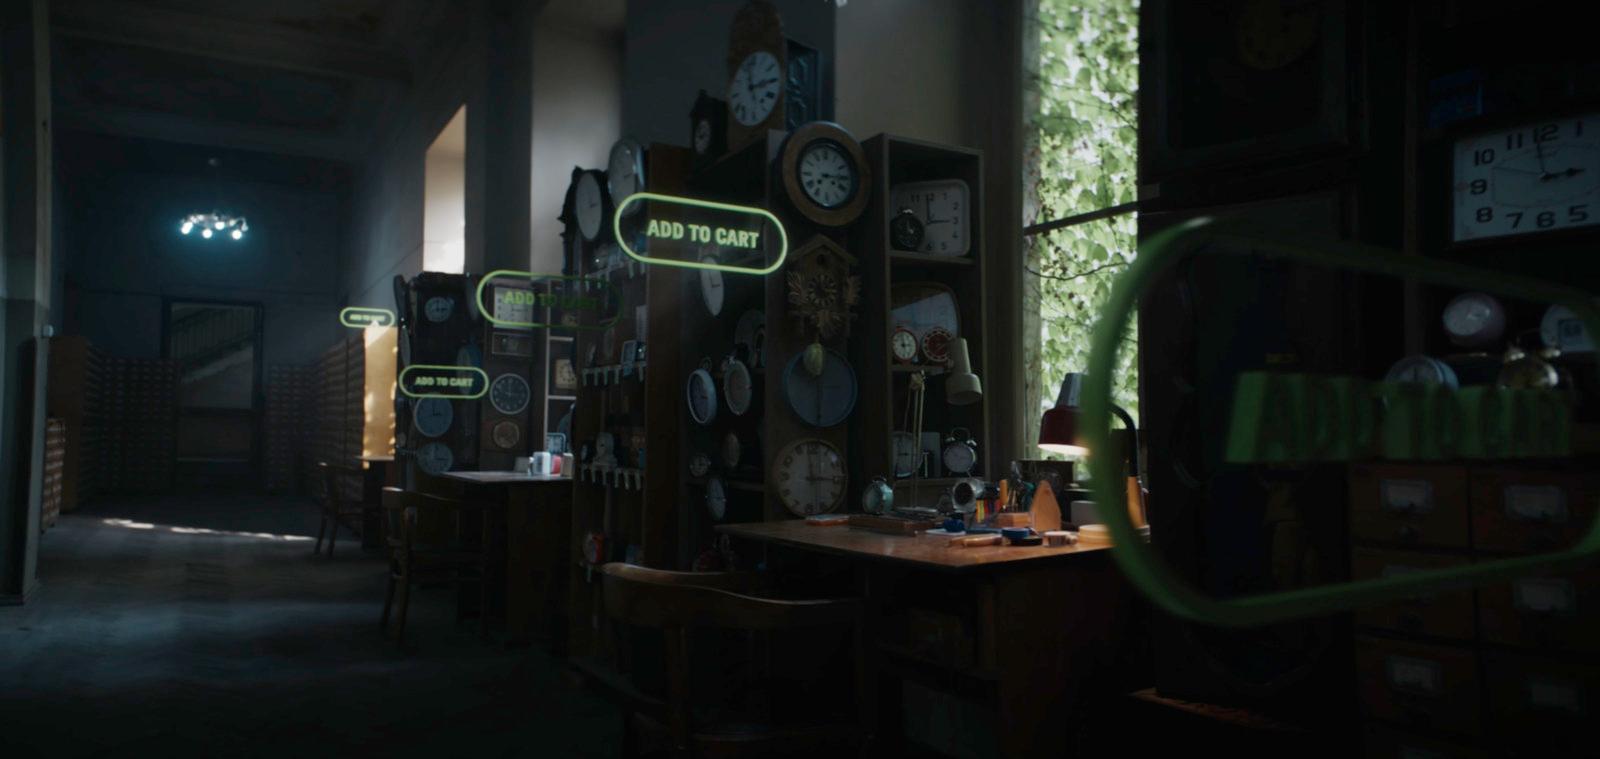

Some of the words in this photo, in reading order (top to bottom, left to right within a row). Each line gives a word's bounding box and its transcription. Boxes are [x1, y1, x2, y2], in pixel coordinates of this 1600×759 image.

[1507, 133, 1522, 150] 11
[1533, 123, 1558, 143] 12
[1474, 149, 1495, 166] 10
[1470, 179, 1487, 195] 9
[1476, 207, 1493, 223] 8
[1506, 212, 1523, 228] 7
[1537, 211, 1556, 228] 6
[1569, 205, 1588, 222] 5
[646, 219, 685, 240] ADD
[687, 223, 711, 243] TO
[714, 227, 760, 249] CART
[503, 290, 535, 305] ADD
[414, 376, 434, 386] ADD
[436, 376, 449, 387] TO
[449, 377, 474, 388] CART
